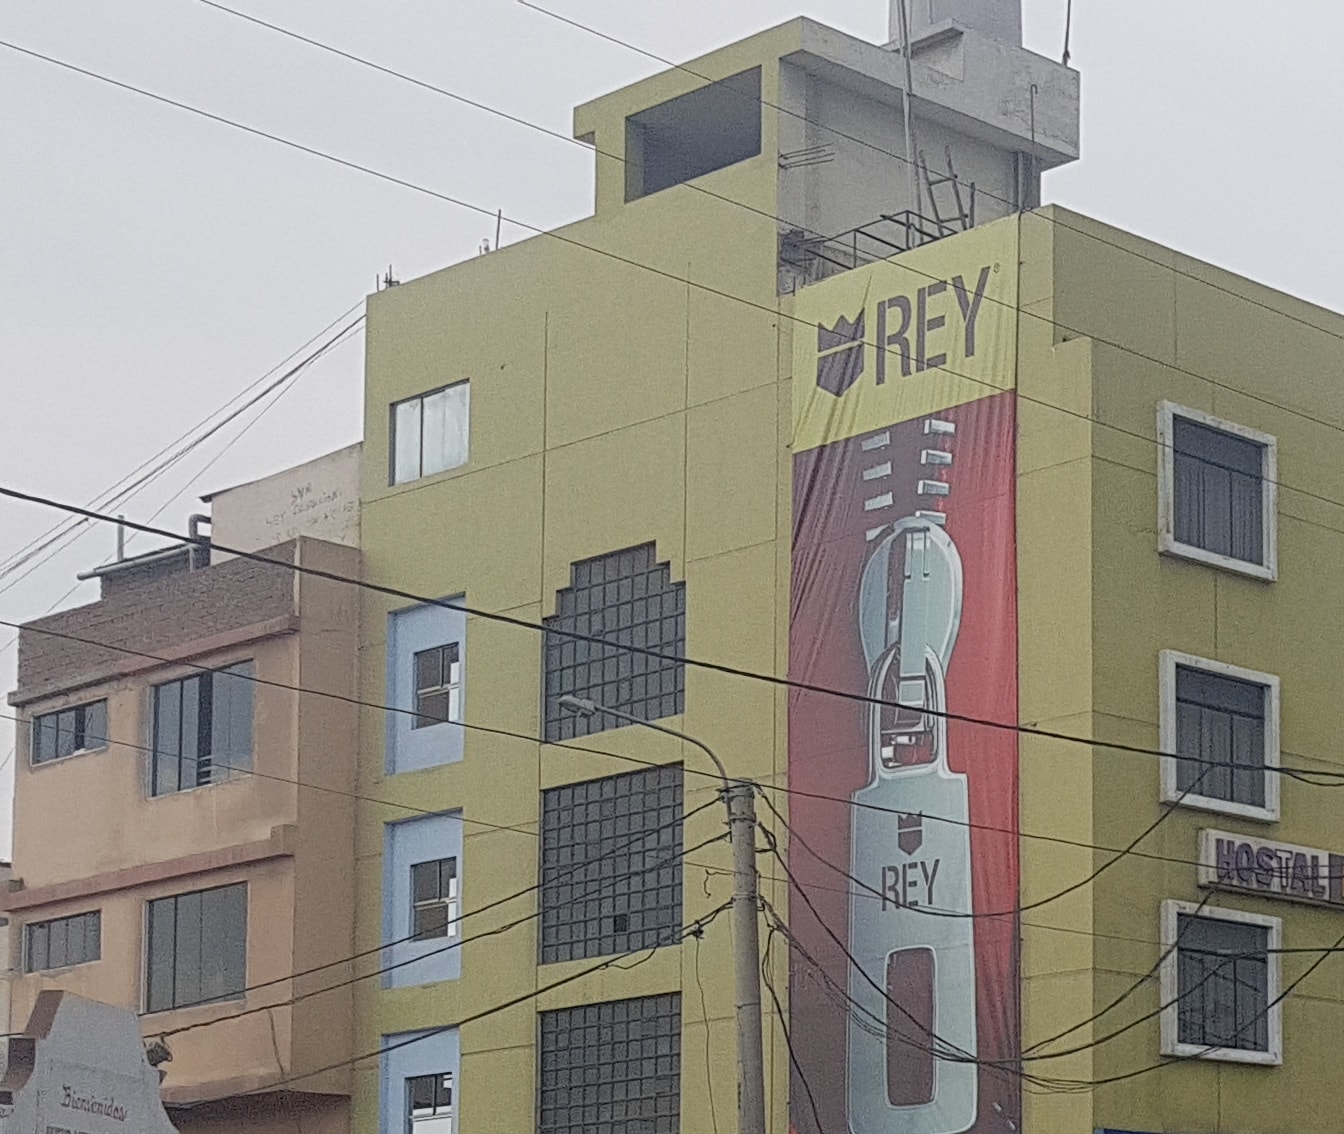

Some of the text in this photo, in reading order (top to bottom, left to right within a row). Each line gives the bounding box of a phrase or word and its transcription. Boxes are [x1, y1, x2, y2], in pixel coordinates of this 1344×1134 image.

[876, 266, 991, 385] REY
[882, 859, 939, 911] REY
[1216, 838, 1326, 896] HOSTAL
[61, 1084, 128, 1122] Bienvenidos
